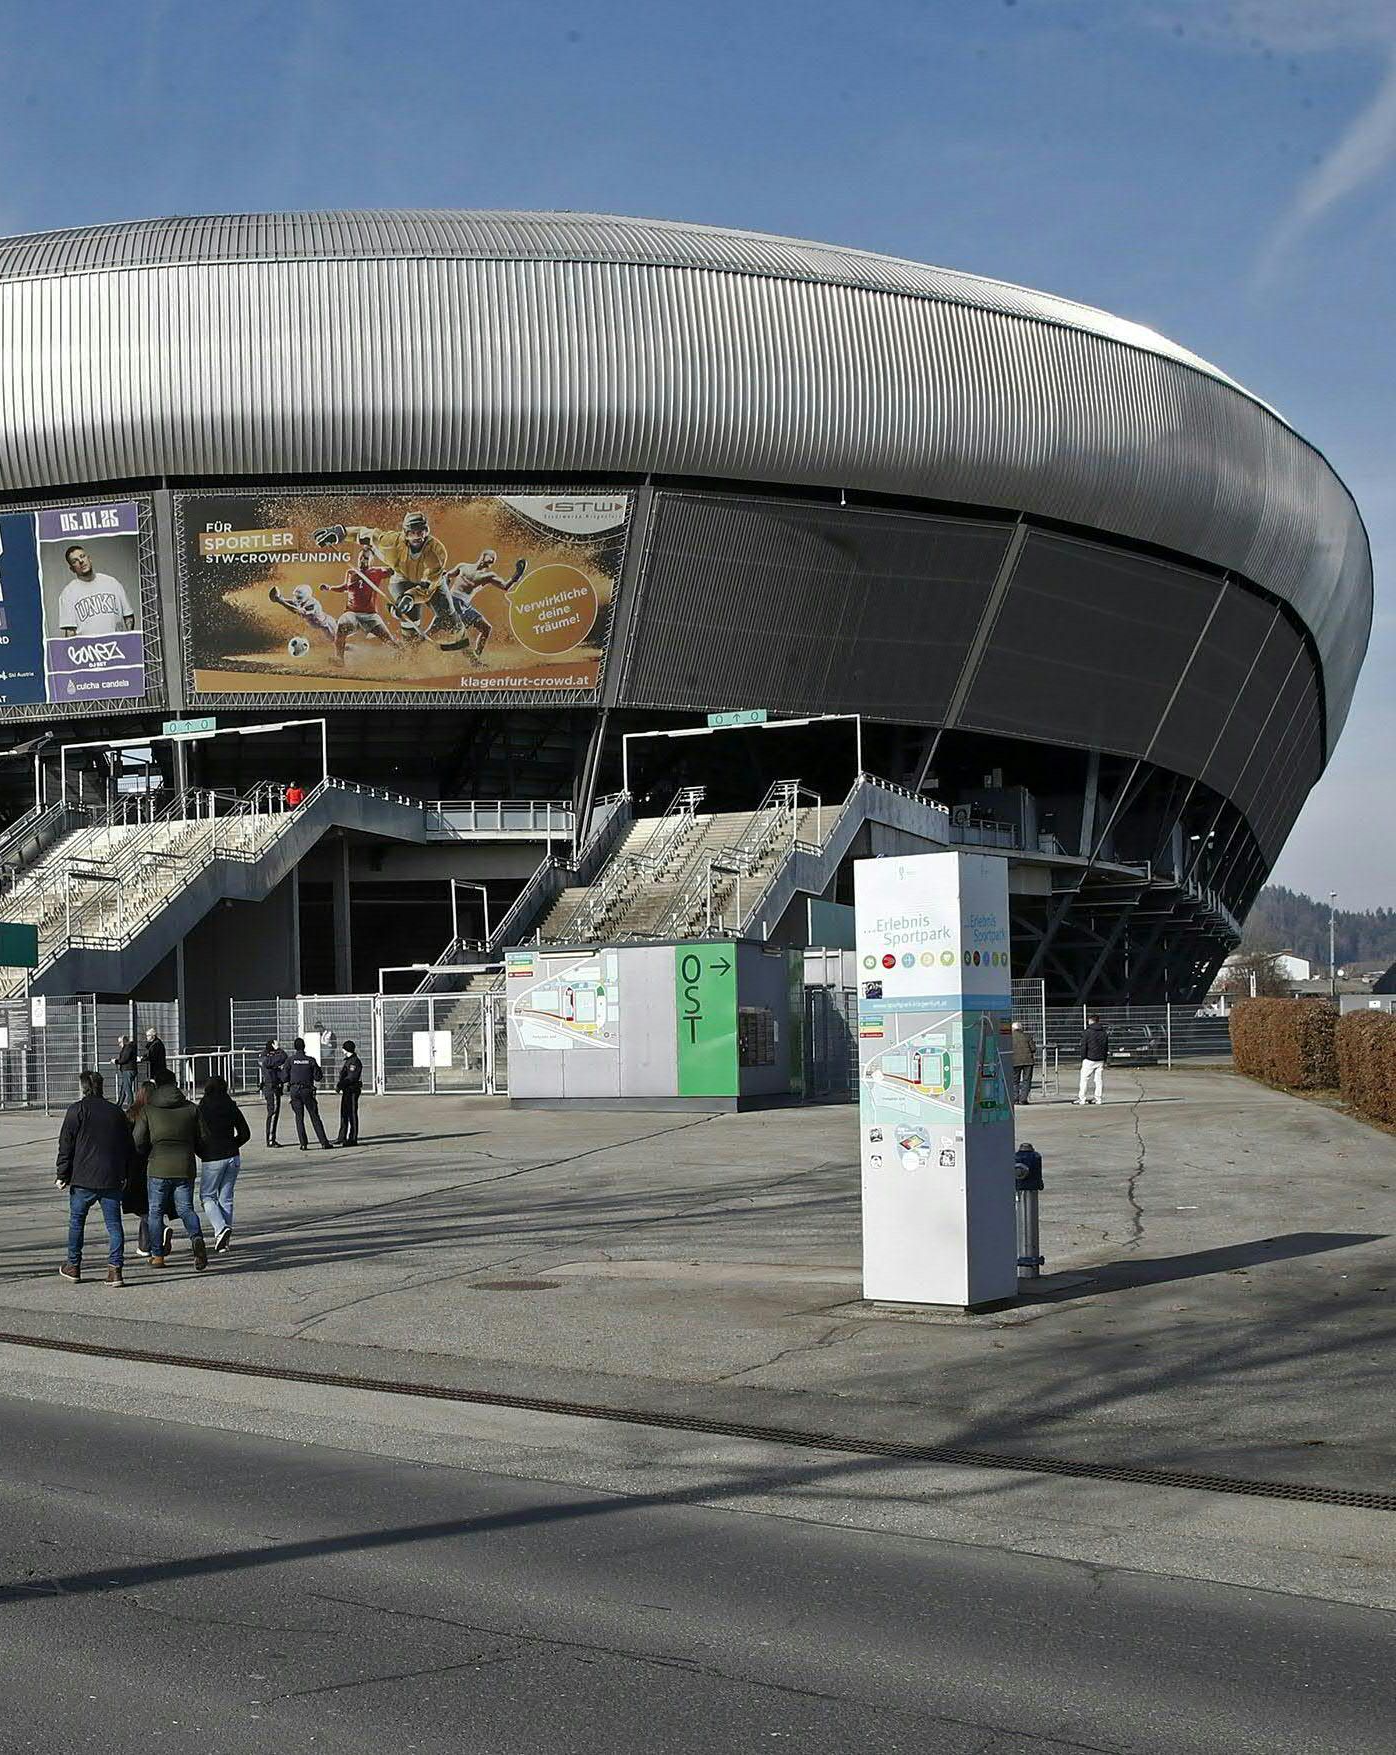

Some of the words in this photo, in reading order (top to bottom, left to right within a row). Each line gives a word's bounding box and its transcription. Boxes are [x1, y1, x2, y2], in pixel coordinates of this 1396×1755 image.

[554, 502, 613, 512] STW
[60, 509, 119, 531] 05.01.25
[206, 520, 233, 533] FÜR
[204, 533, 294, 551] SPORTLER
[205, 552, 351, 563] STW-CROWDFUNDING
[516, 587, 589, 615] Verwirkliche
[537, 605, 572, 620] deine
[533, 613, 581, 635] Träume!
[76, 681, 100, 690] culcha
[101, 680, 130, 689] candela
[461, 676, 589, 688] klagenfurt-crowd.at
[883, 925, 952, 948] Sportpark
[682, 954, 703, 1044] OST
